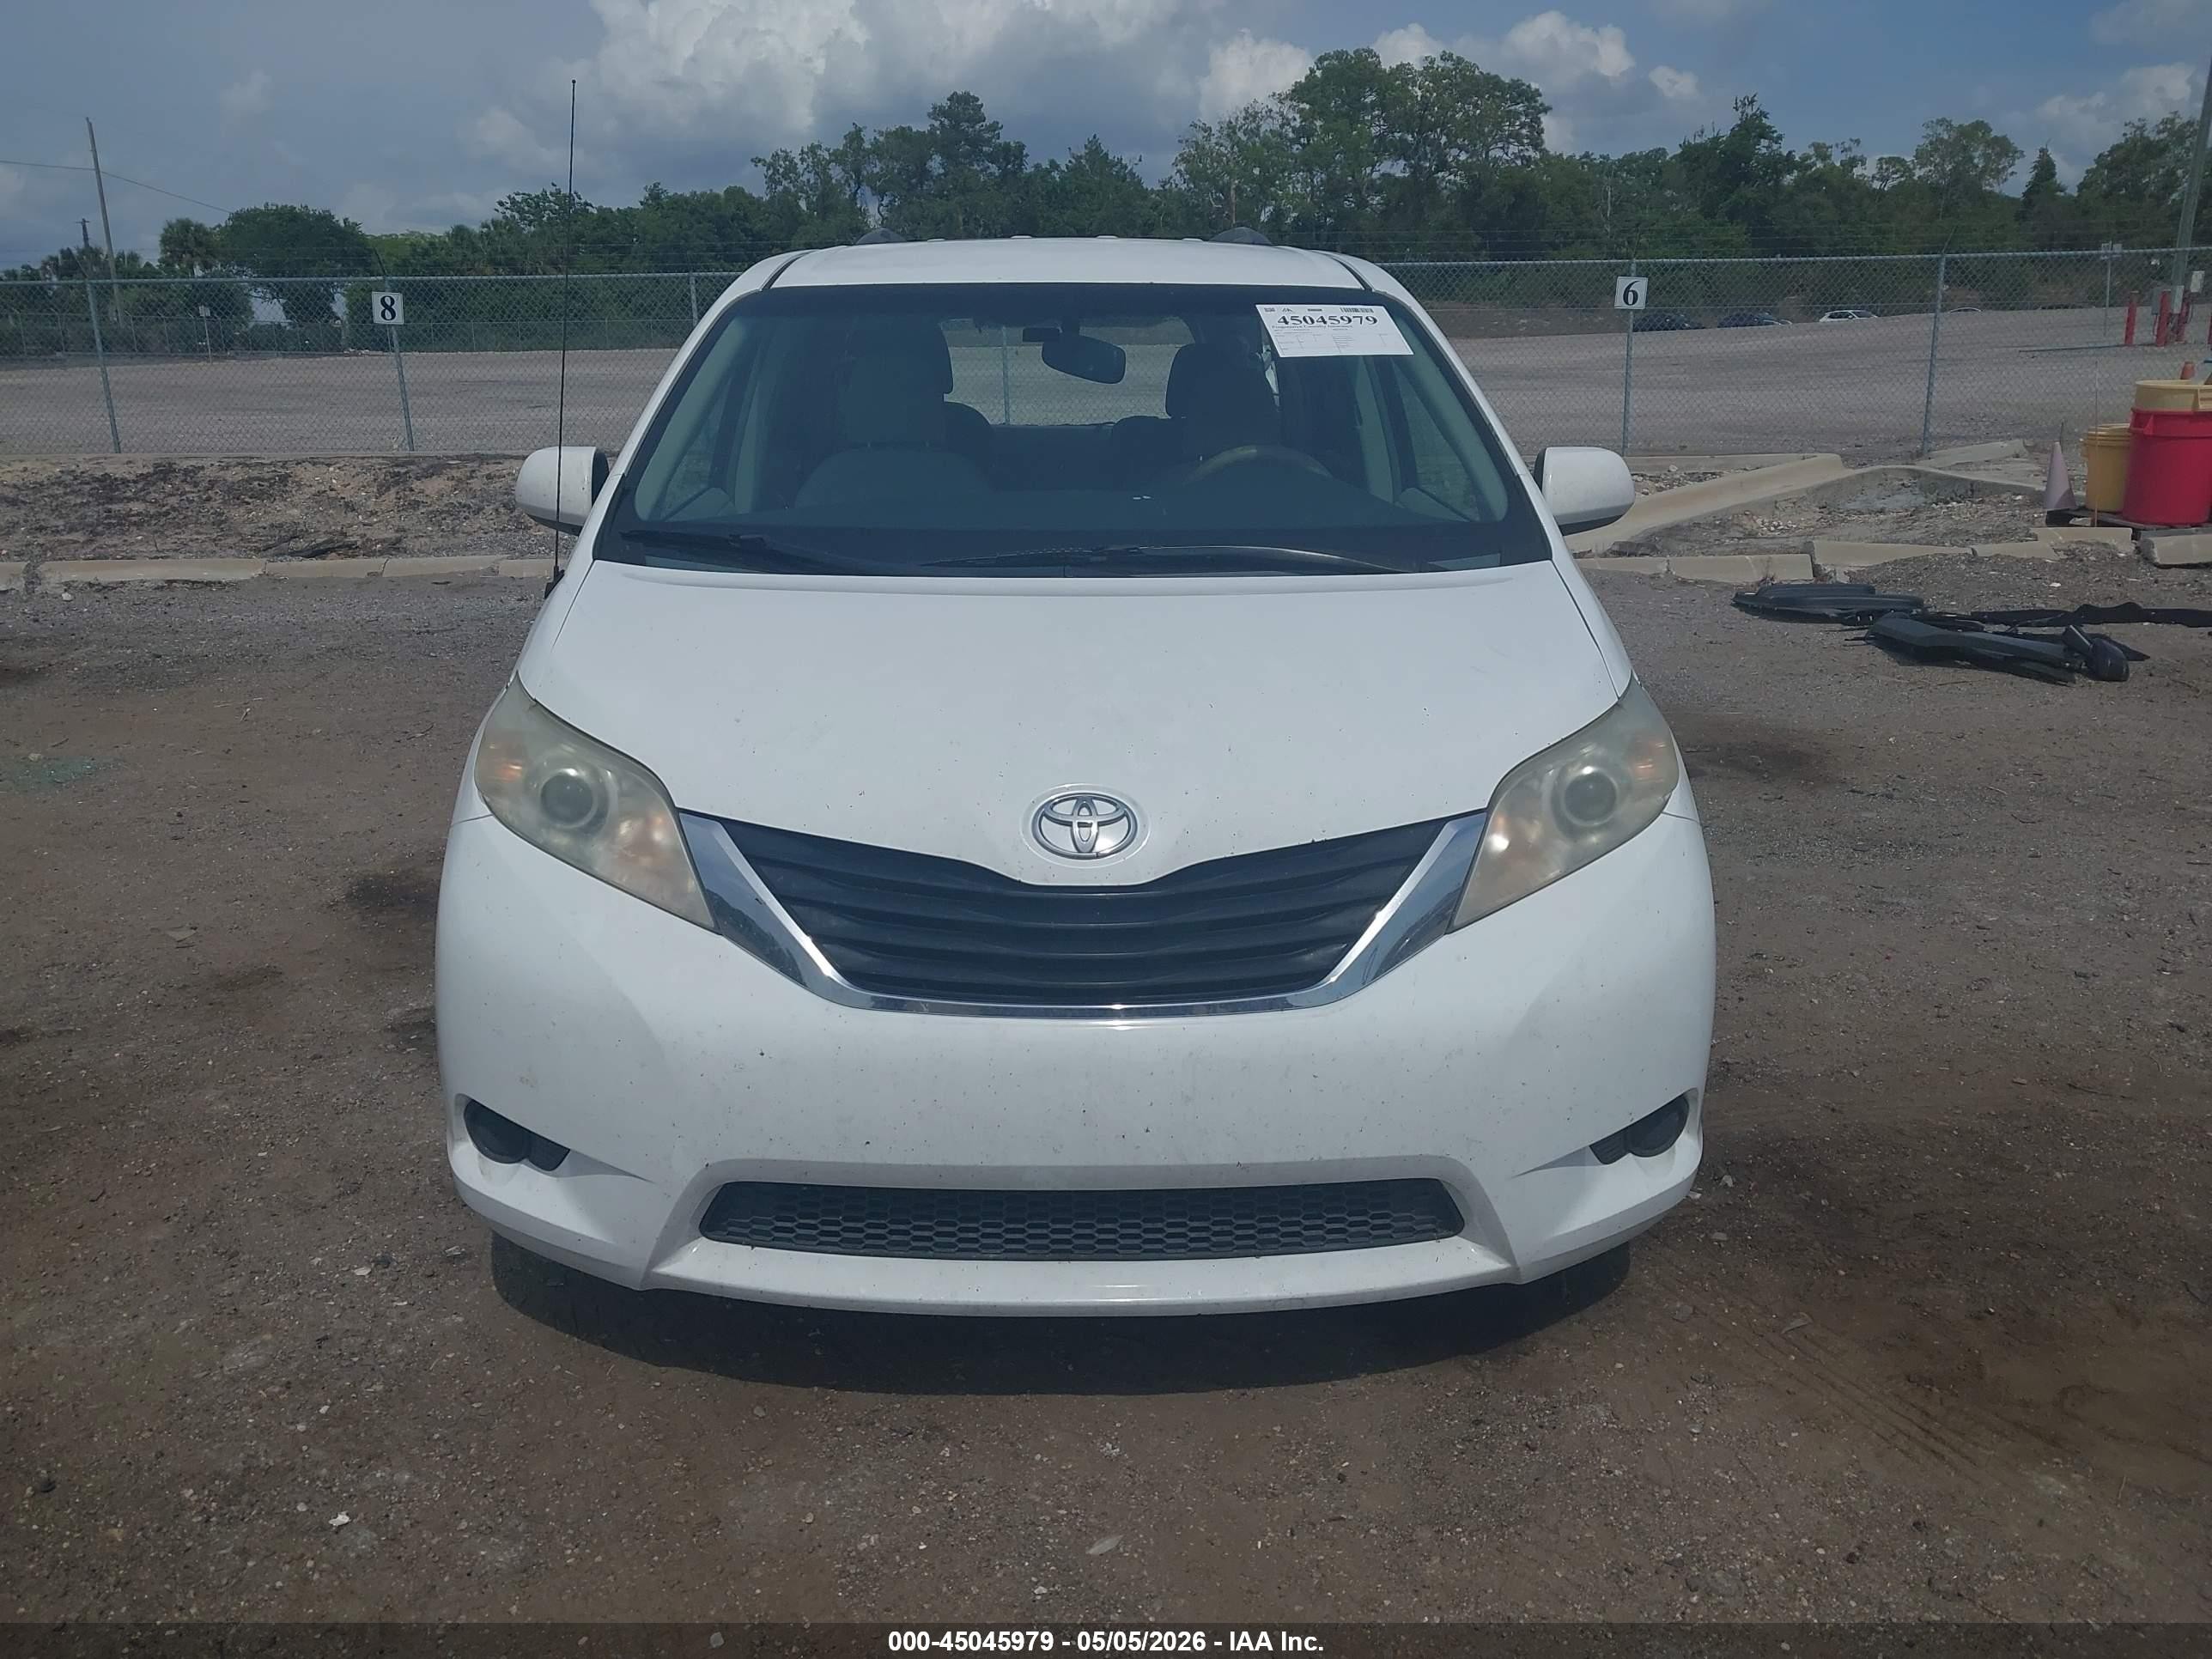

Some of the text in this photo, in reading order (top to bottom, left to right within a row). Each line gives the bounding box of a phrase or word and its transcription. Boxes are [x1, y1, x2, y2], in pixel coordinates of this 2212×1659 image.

[1623, 280, 1641, 306] 6
[380, 295, 396, 321] 8
[1277, 315, 1378, 325] 45045979
